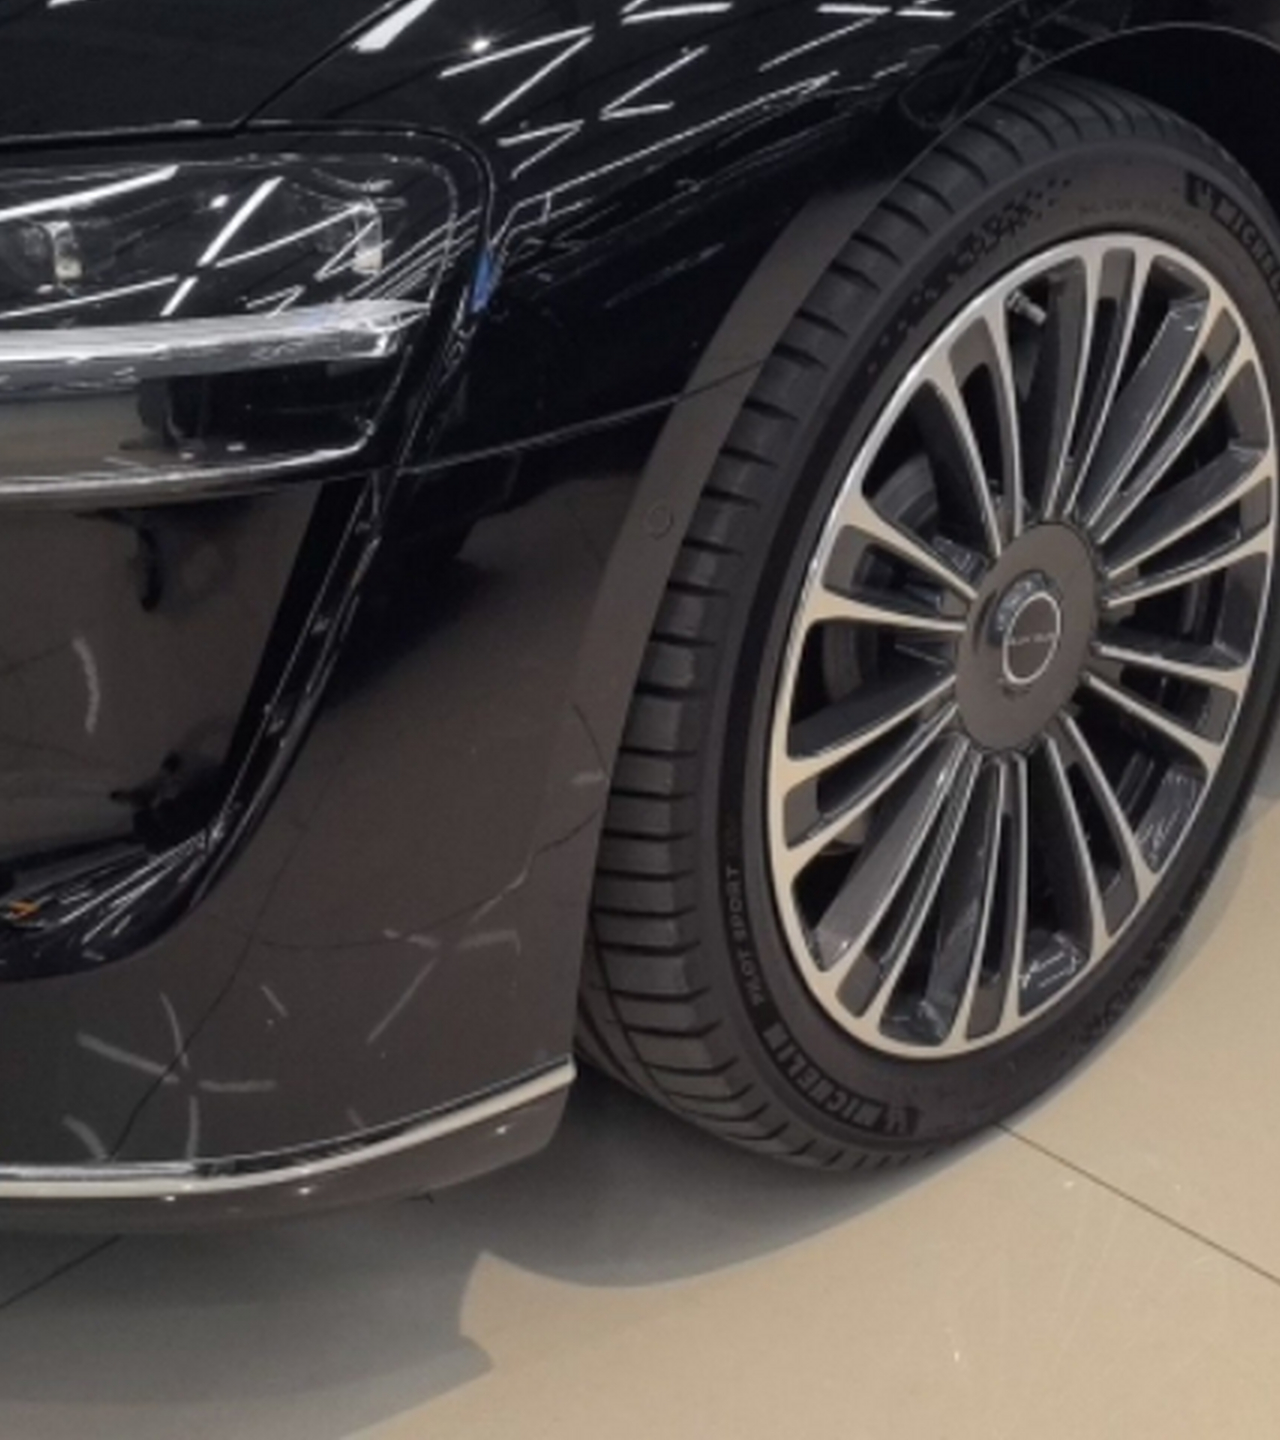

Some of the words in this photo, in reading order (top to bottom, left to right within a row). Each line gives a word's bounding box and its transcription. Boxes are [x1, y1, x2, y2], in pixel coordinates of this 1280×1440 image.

[725, 864, 746, 942] SPORT
[738, 949, 766, 1007] PILOT
[763, 1022, 887, 1129] MICHELIN
